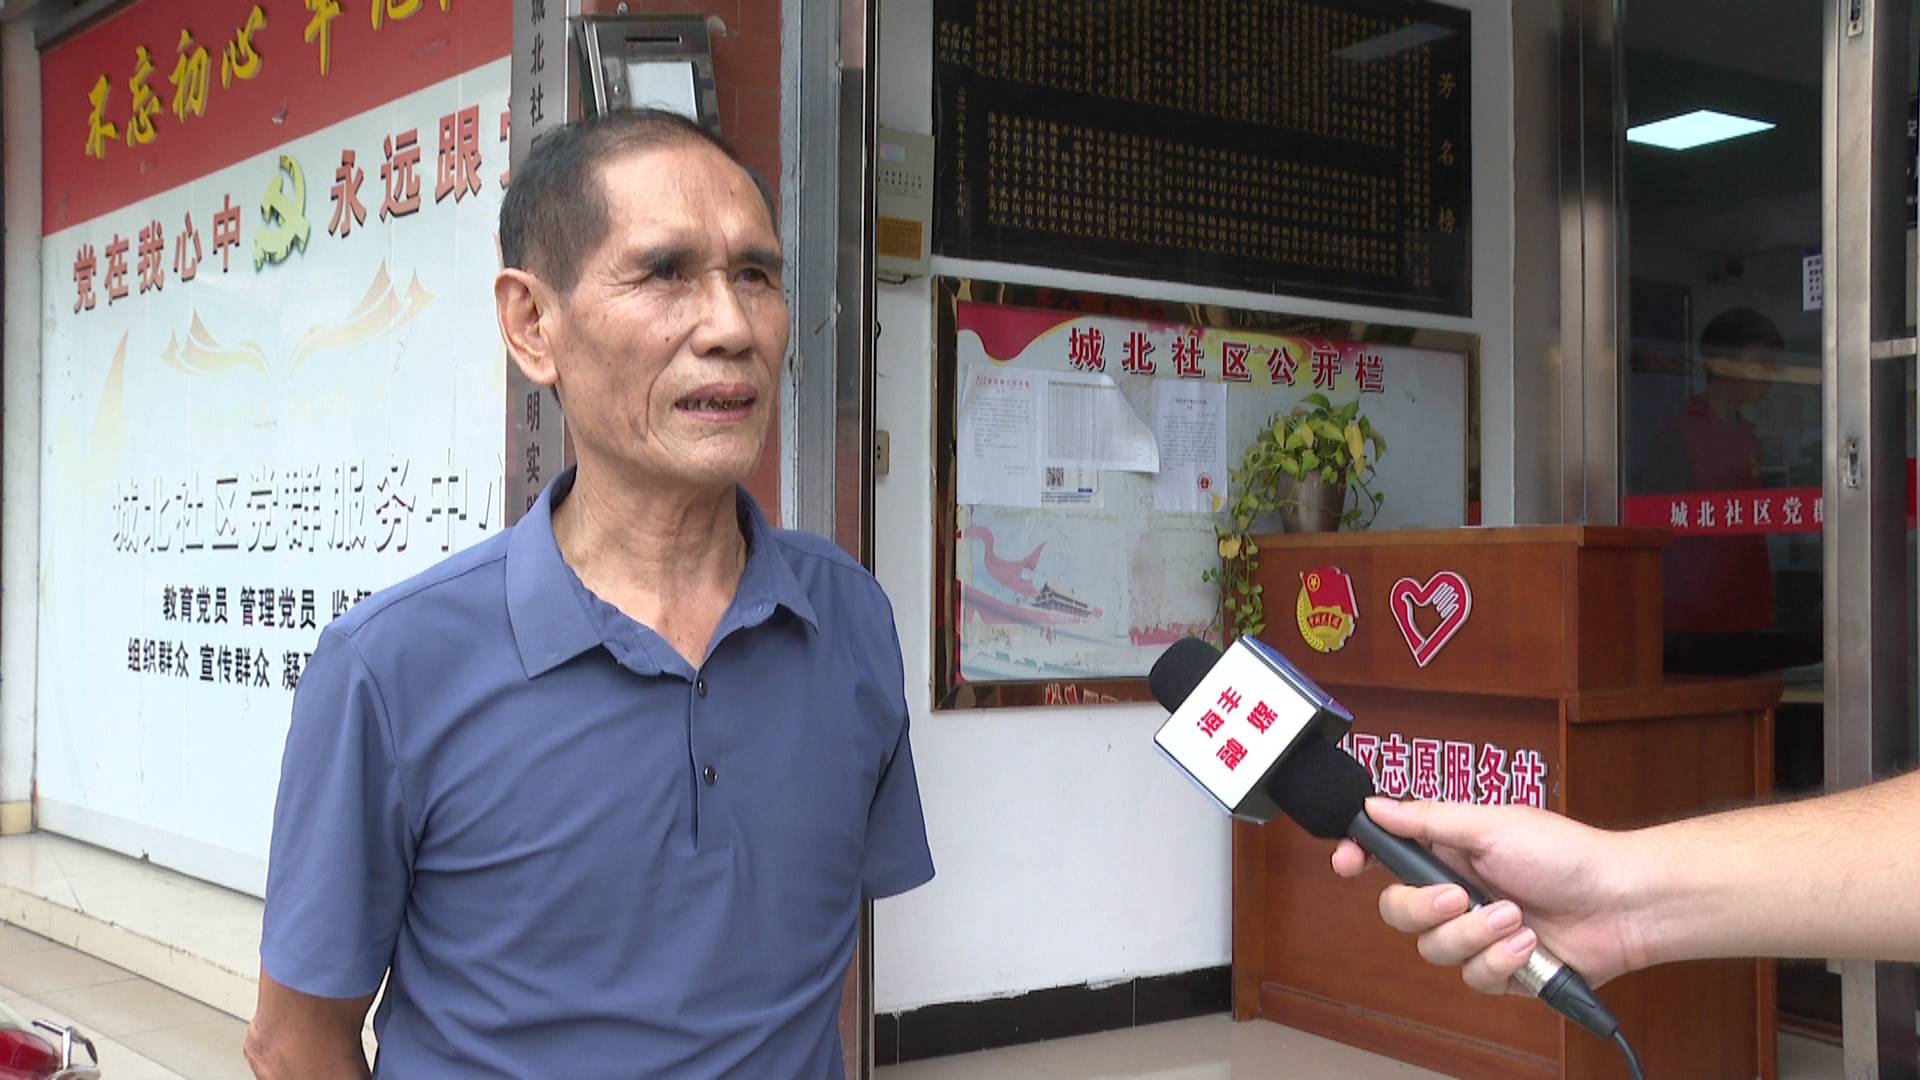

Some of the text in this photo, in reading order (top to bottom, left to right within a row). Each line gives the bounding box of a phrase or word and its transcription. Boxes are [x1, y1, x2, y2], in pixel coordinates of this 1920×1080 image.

[85, 4, 268, 159] 不忘初心
[531, 0, 546, 150] 城北社
[1436, 71, 1457, 235] 芳名榜
[73, 104, 512, 314] 党在我心中 永远跟
[1069, 327, 1385, 393] 城北社区公开栏
[163, 585, 228, 624] 教育党员
[240, 585, 316, 629] 管理党员
[127, 637, 312, 691] 组织群众 宣传群众 凝
[1197, 686, 1242, 738] 海丰
[1216, 700, 1278, 771] 融媒
[1337, 732, 1546, 808] 区志愿服务站
